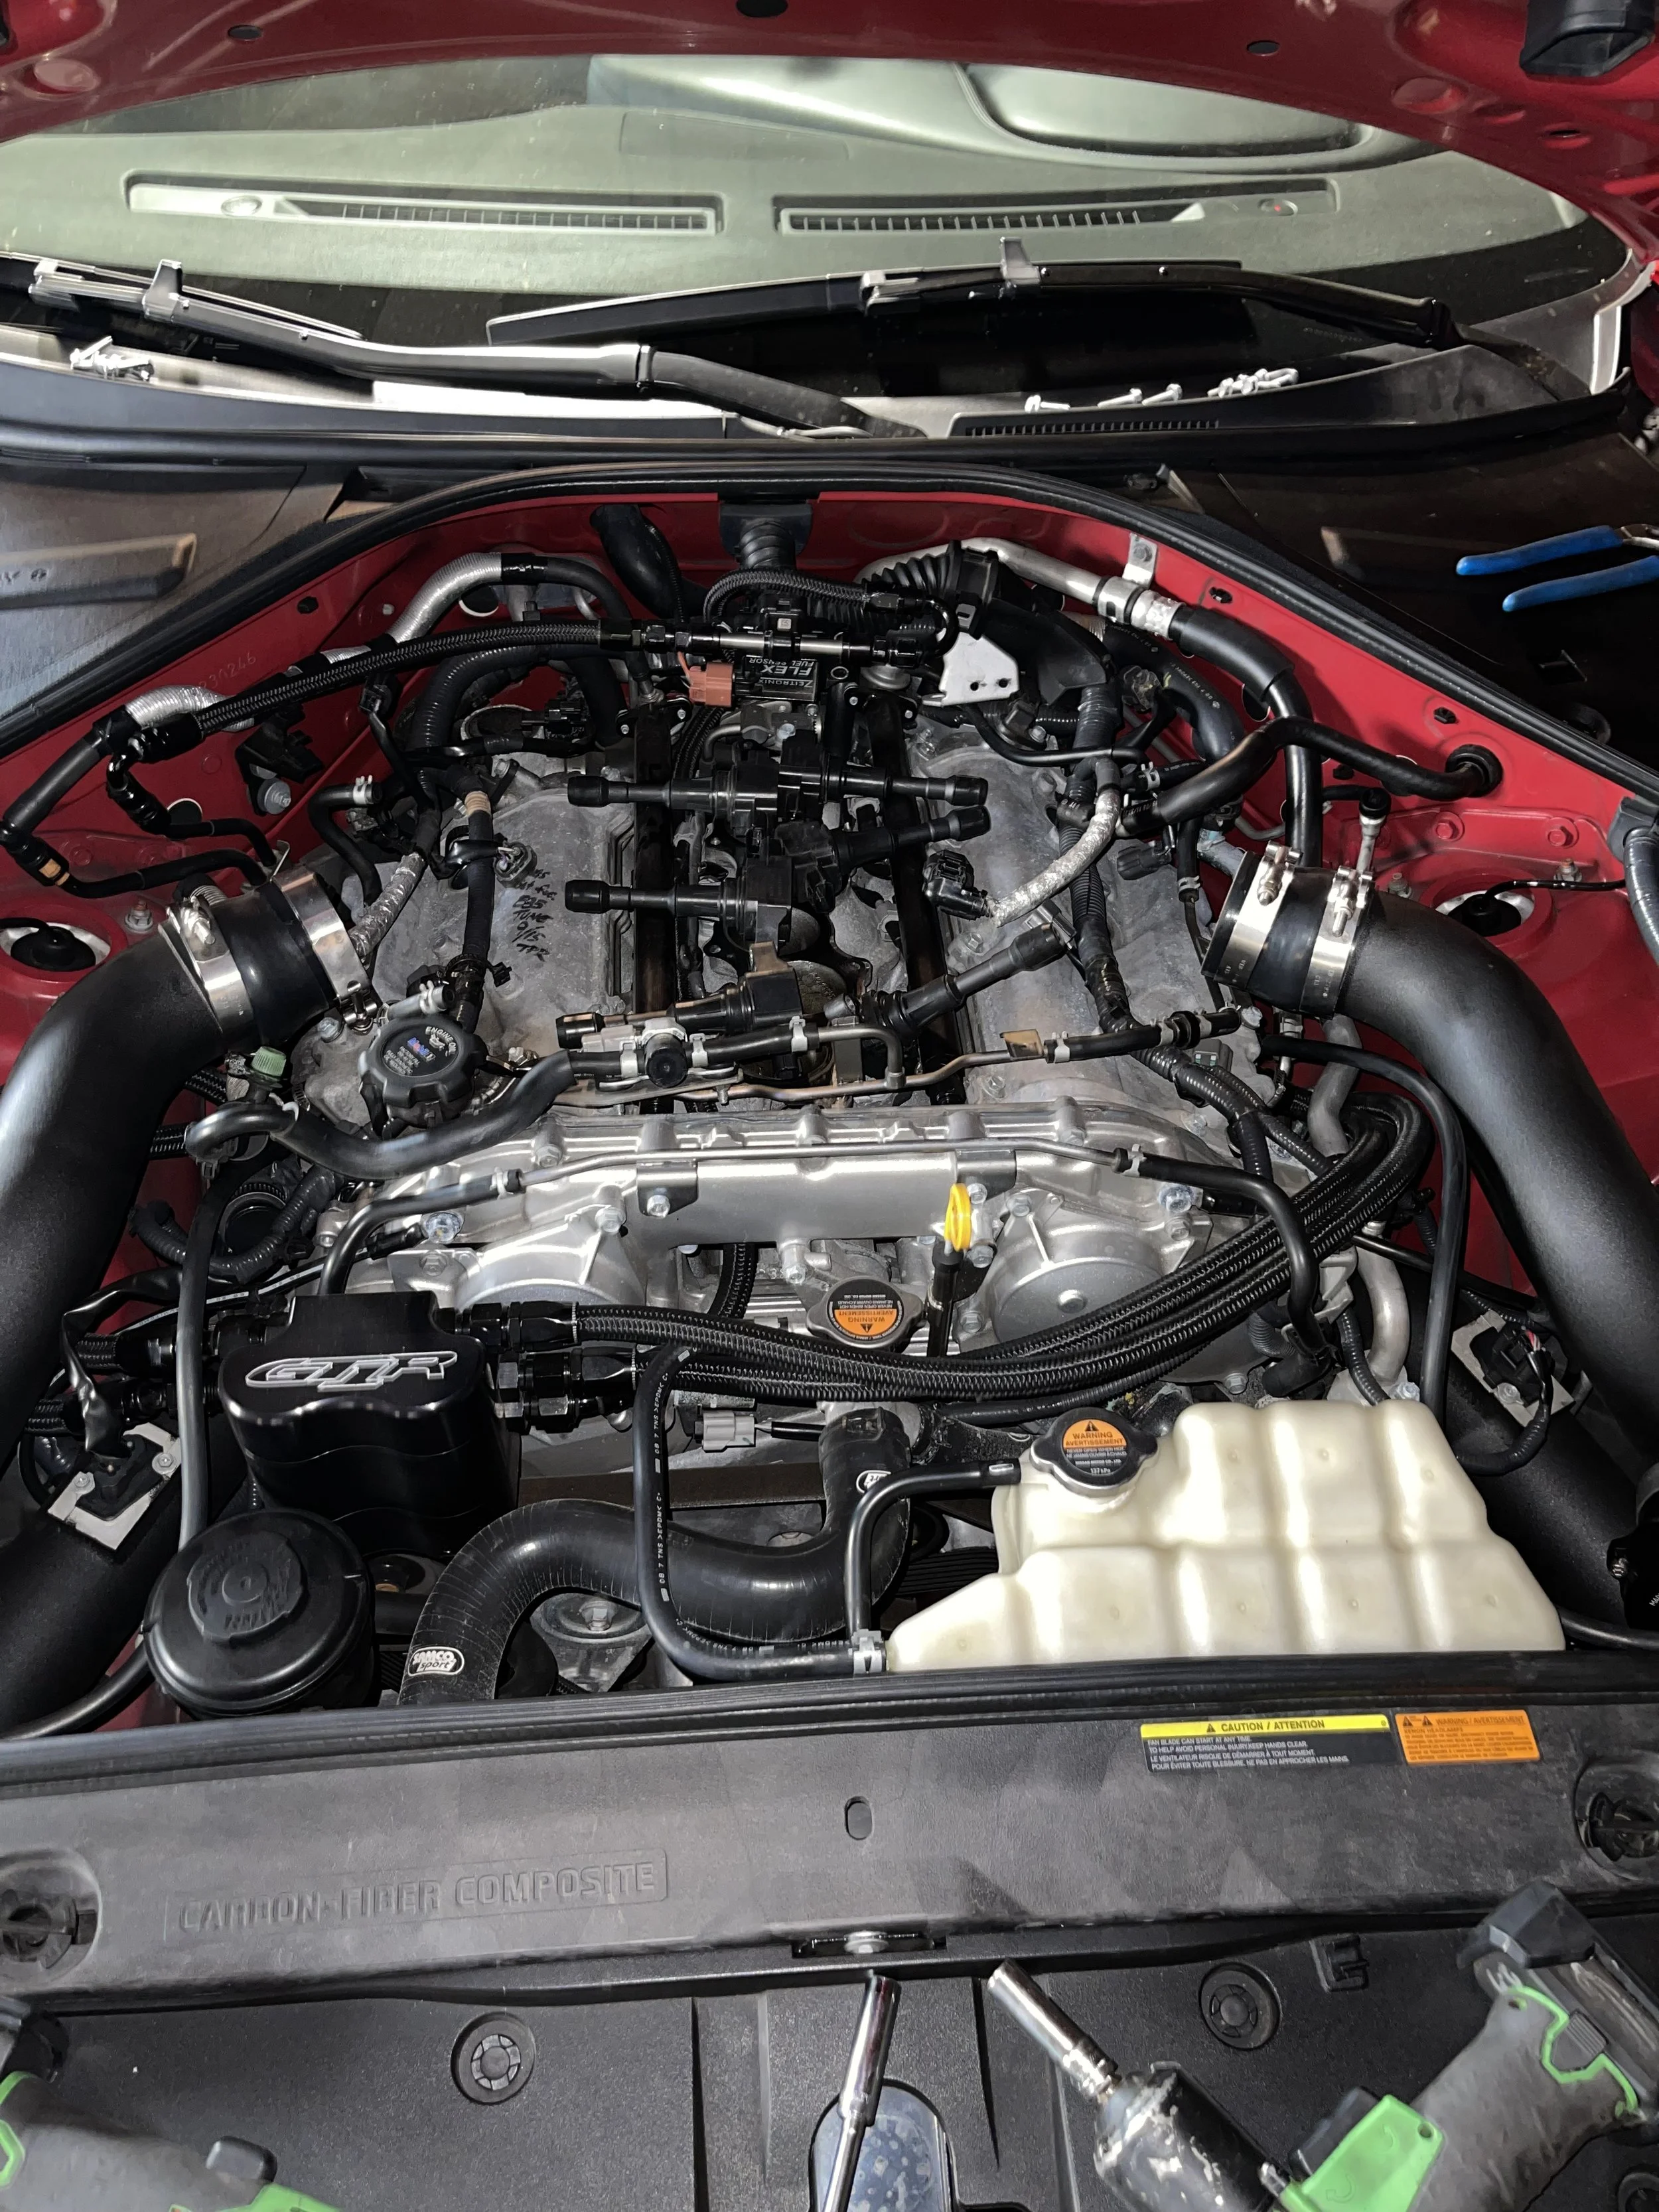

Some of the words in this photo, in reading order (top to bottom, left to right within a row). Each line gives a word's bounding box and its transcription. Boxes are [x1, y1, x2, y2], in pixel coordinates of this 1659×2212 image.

[760, 665, 812, 675] FLEX
[425, 1026, 454, 1043] ENGINE
[413, 1650, 454, 1665] SAMCO
[420, 1661, 450, 1671] sport
[1221, 1722, 1263, 1732] CAUTION
[1266, 1722, 1271, 1731] /
[1274, 1720, 1325, 1730] ATTENTION
[1474, 1716, 1524, 1724] AVERTISSEMENT
[455, 1862, 654, 1906] COMPOSITE
